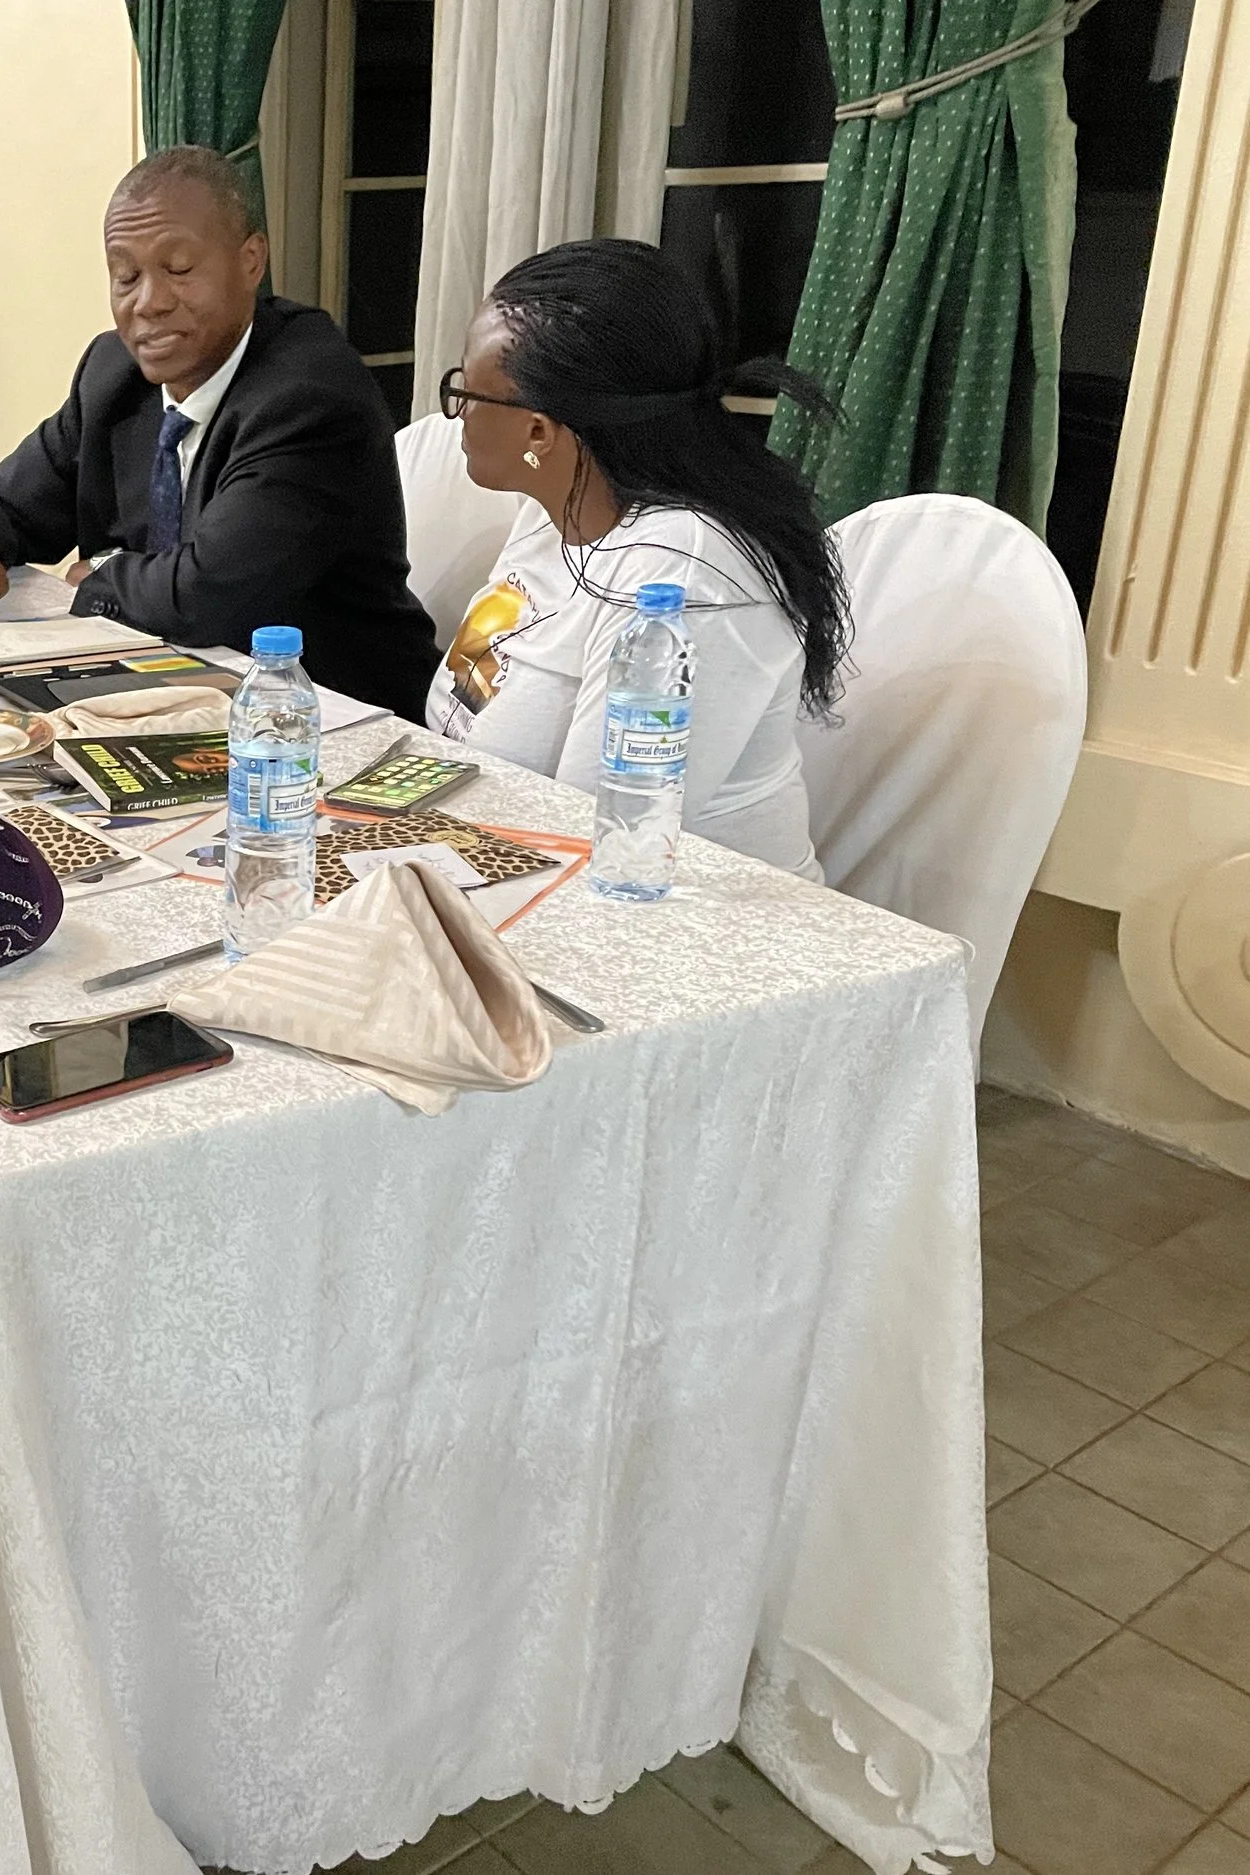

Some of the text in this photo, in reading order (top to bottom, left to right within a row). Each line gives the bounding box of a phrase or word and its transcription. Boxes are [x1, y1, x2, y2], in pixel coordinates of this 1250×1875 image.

[626, 742, 652, 756] Imperial
[81, 744, 145, 793] GRIEF CHILD
[152, 797, 178, 807] CHILD
[274, 798, 299, 811] Imperial
